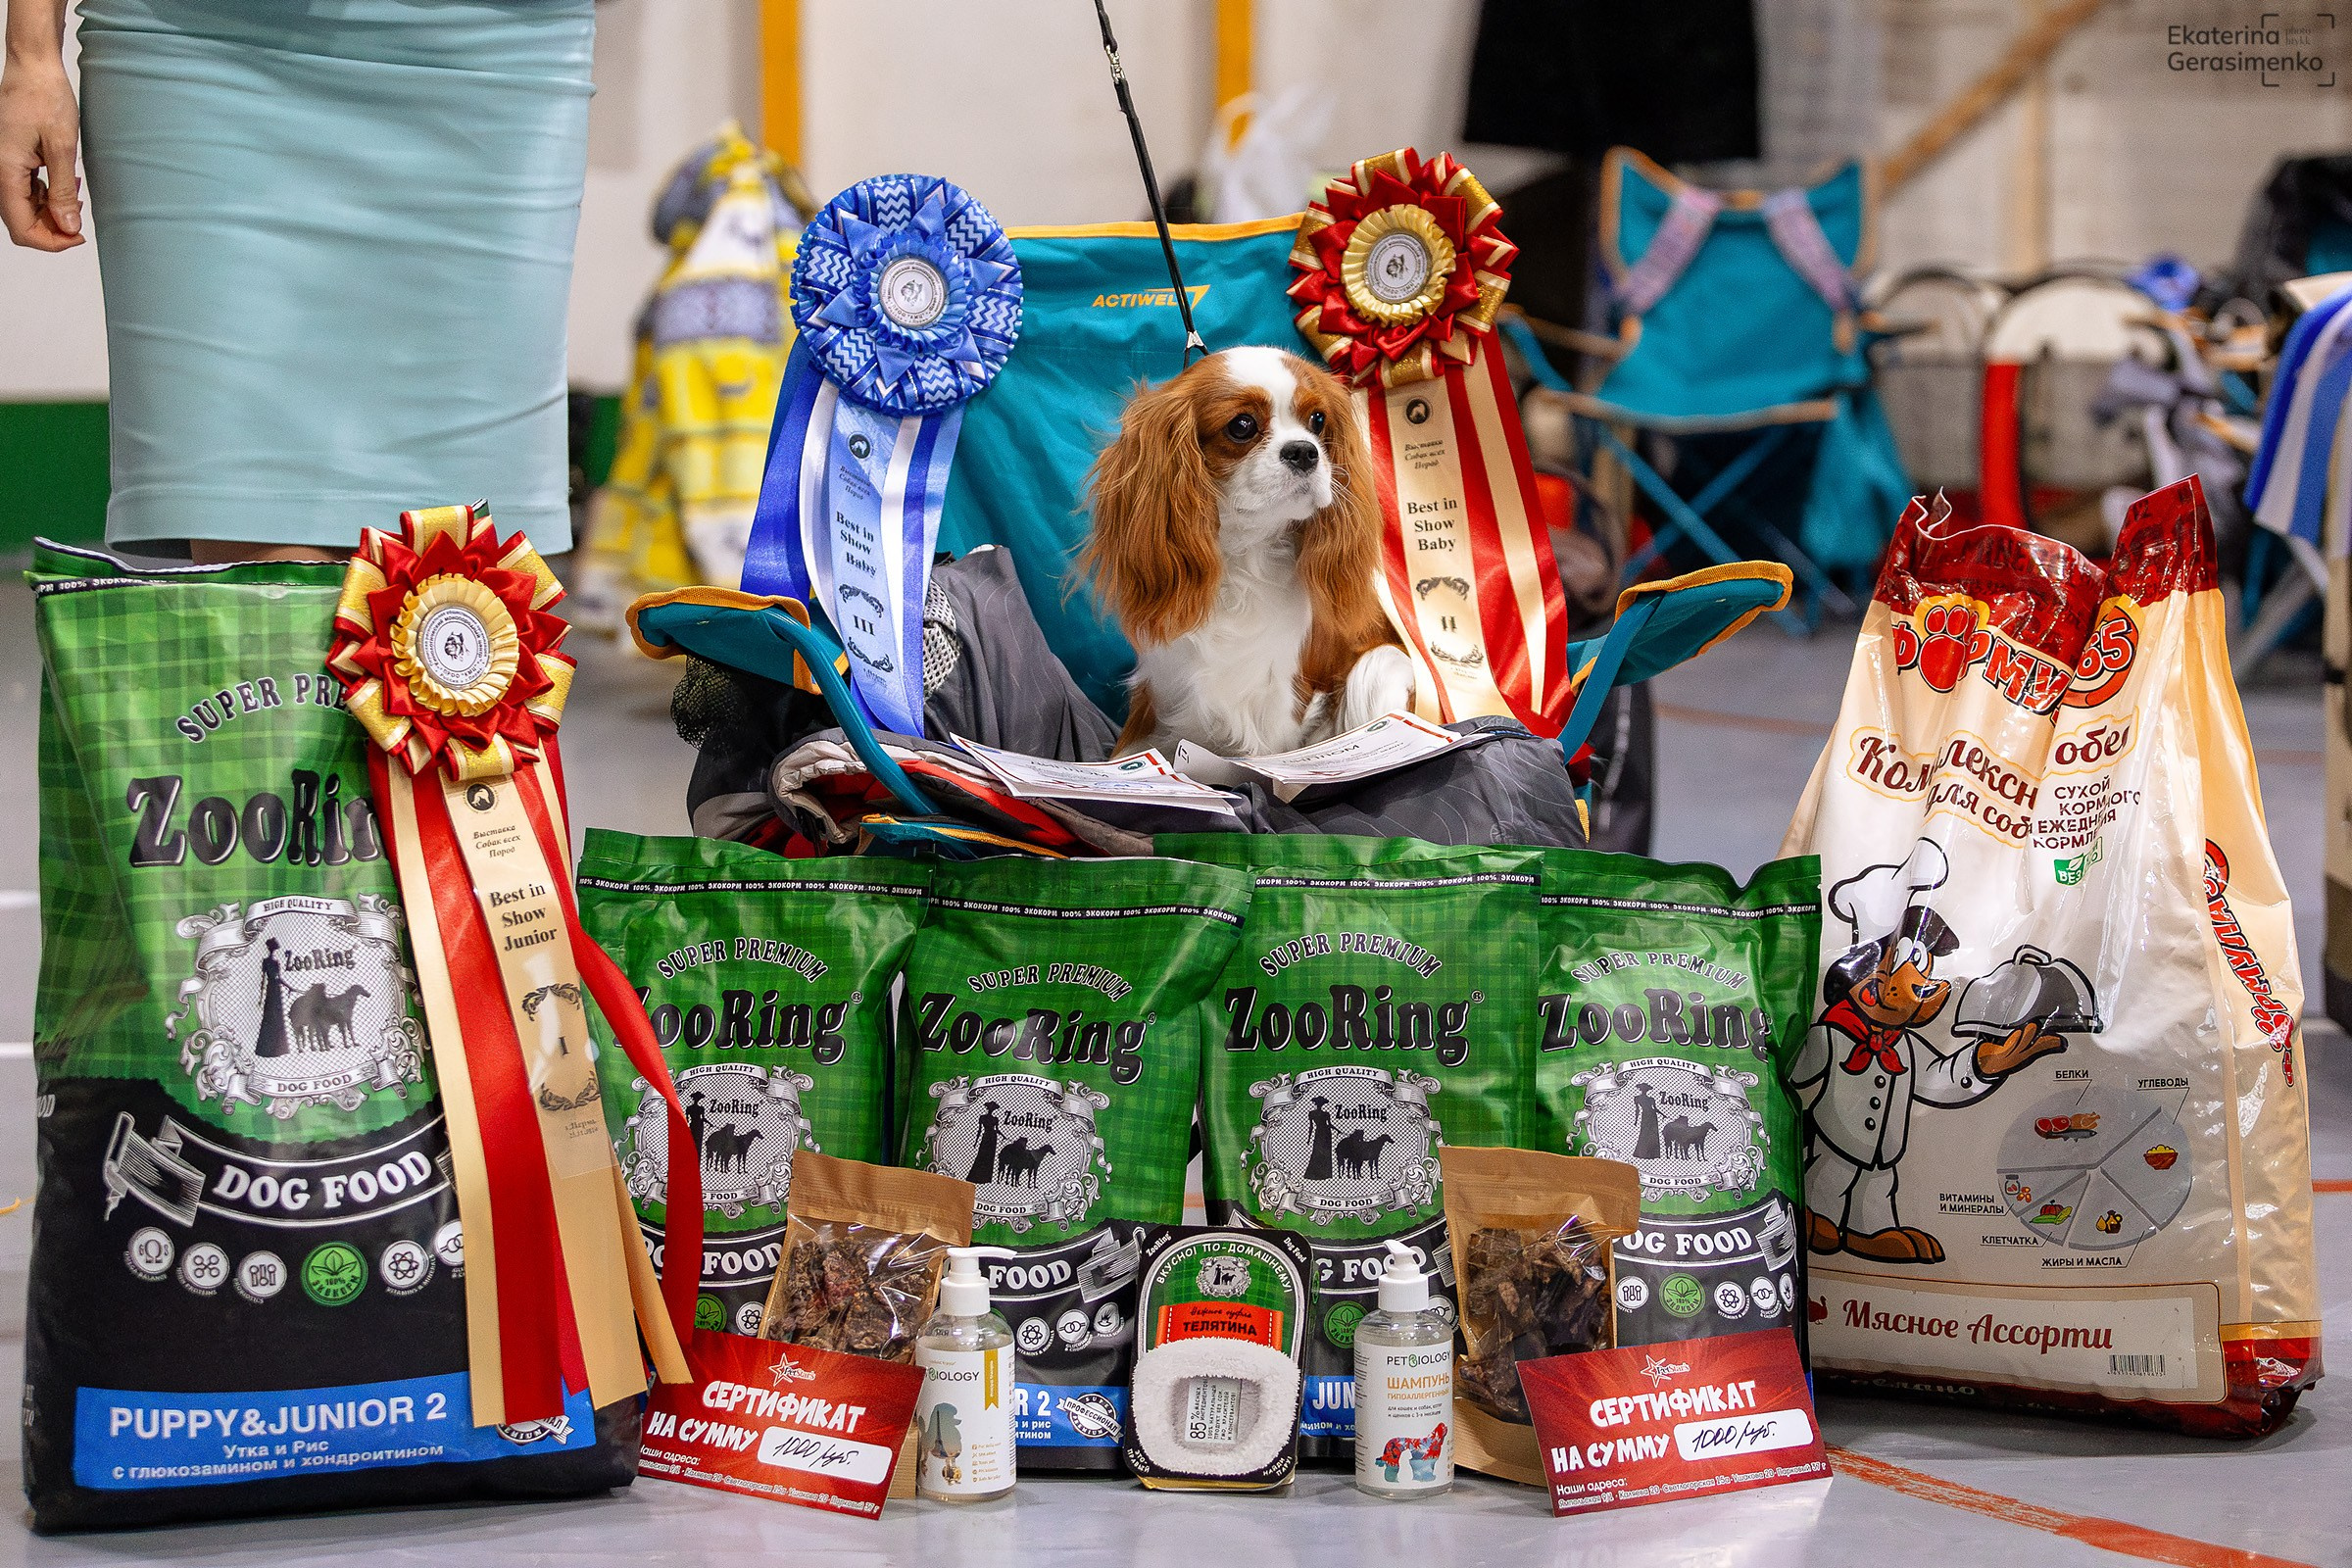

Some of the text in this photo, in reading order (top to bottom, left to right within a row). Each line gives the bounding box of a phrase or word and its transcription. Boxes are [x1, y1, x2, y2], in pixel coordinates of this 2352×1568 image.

[1092, 293, 1182, 308] ACTIWEL
[1407, 497, 1458, 515] Best in
[836, 511, 875, 543] Best in
[1414, 518, 1455, 533] Show
[840, 528, 872, 557] Show
[1418, 537, 1456, 553] Baby
[846, 551, 877, 579] Baby
[176, 676, 283, 744] SUPER
[2055, 724, 2130, 766] обе
[2054, 774, 2111, 800] СУХОЙ
[126, 767, 388, 868] ZooRin
[1983, 802, 2034, 841] соб
[473, 824, 516, 840] Выставка
[475, 834, 522, 851] Собак всех
[489, 846, 516, 858] Пород
[595, 878, 865, 891] ЭКОКОРМ ЭКОКОРМ ЭКОКОРМ ЭКОКОРМ
[1438, 874, 1535, 886] ЭКОКОРМ ЭКОКОРМ
[264, 898, 334, 912] HIGH QUALITY
[490, 882, 547, 908] Best in
[501, 907, 548, 929] Show
[963, 901, 999, 911] ЭКОКОРМ
[1024, 907, 1058, 916] ЭКОКОРМ
[1202, 907, 1239, 924] ЭКОКОРМ
[1613, 900, 1764, 918] ЭКОКОРМ ЭКОКОРМ ЭКОКОРМ
[504, 927, 559, 953] Junior
[284, 945, 355, 973] ZooRing
[657, 937, 829, 984] SUPER PREMIUM
[1259, 932, 1443, 979] SUPER PREMIUM
[1572, 951, 1749, 990] SUPER PREMIUM
[967, 962, 1134, 1003] SUPER PREMIUM
[1224, 984, 1470, 1067] ZooRing
[918, 992, 1149, 1086] ZooRing
[689, 1064, 756, 1077] HIGH QUALITY
[1306, 1067, 1380, 1079] HIGH QUALITY
[1630, 1058, 1698, 1070] HIGH QUALITY
[2055, 1069, 2089, 1080] БЕЛКИ
[276, 1073, 353, 1093] DOG FOOD
[984, 1075, 1053, 1088] HIGH QUALITY
[2137, 1077, 2189, 1089] УГЛЕВОДЫ
[709, 1099, 760, 1118] ZooRing
[1335, 1103, 1387, 1122] ZooRing
[1659, 1091, 1709, 1111] ZooRing
[1003, 1109, 1054, 1133] ZooRing
[213, 1150, 433, 1211] DOG FOOD
[1649, 1176, 1702, 1186] DOG FOOD
[710, 1192, 739, 1201] FOOD
[1319, 1197, 1374, 1208] DOG FOOD
[1939, 1193, 1995, 1203] ВИТАМИНЫ
[975, 1202, 1027, 1215] DOG FOOD
[1939, 1203, 2005, 1215] И МИНЕРАЛЫ
[1146, 1233, 1174, 1258] ZooRing
[1282, 1236, 1308, 1264] Dog Food
[1622, 1227, 1752, 1256] OG FOOD
[1982, 1235, 2039, 1246] КЛЕТЧАТКА
[702, 1242, 784, 1276] FOOD
[1201, 1242, 1294, 1294] ПО-ДОМАШНЕМУ!
[2041, 1256, 2123, 1268] ЖИРЫ И МАСЛА
[988, 1259, 1072, 1290] FOOD
[1665, 1298, 1700, 1312] ЭКОКОРМ
[1182, 1320, 1258, 1337] ТЕЛЯТИНА
[1842, 1298, 2115, 1358] Мясное Ассорти
[1387, 1372, 1450, 1390] ШАМПУНЬ
[703, 1380, 866, 1434] СЕРТИФИКАТ
[1037, 1390, 1052, 1416] 2
[1590, 1380, 1756, 1428] СЕРТИФИКАТ
[109, 1392, 448, 1441] PUPPY&JUNIOR 2
[1031, 1420, 1052, 1430] рис
[1065, 1400, 1119, 1433] ПРОФЕССИОНАЛ
[646, 1411, 760, 1452] НА СУММУ
[1691, 1426, 1737, 1453] 1000
[222, 1440, 330, 1459] Утка и Рис
[663, 1448, 702, 1466] адреса:
[772, 1435, 821, 1458] 1000
[1551, 1433, 1671, 1473] НА СУММУ
[112, 1445, 444, 1480] с глюкозамином и хондроитином
[1127, 1448, 1151, 1473] ПРАВЫЙ
[1262, 1457, 1286, 1477] НАЙДИ
[1556, 1476, 1629, 1496] Наши адреса:
[1662, 1478, 1716, 1494] Светлогорская
[1733, 1471, 1765, 1483] Ушакова
